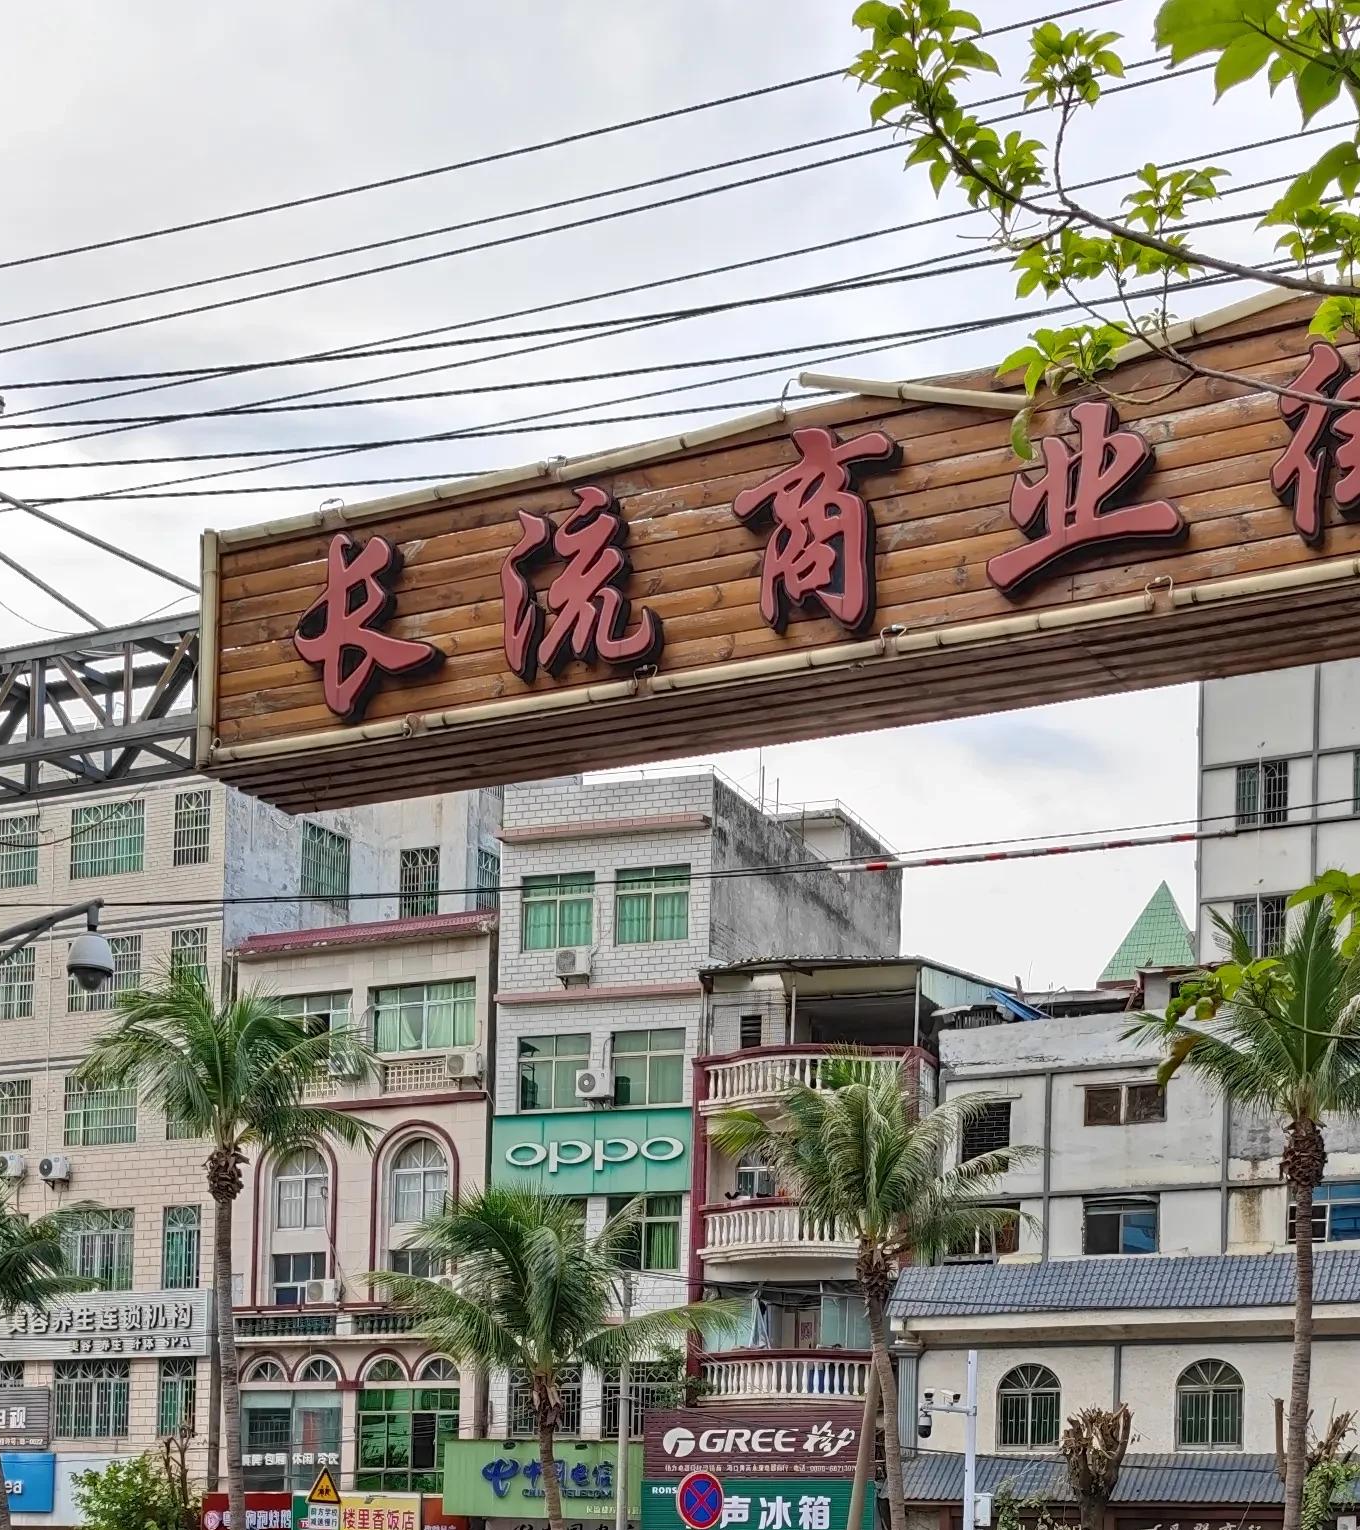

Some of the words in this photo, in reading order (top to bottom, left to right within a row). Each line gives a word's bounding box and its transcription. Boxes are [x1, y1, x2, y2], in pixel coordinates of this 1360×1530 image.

[699, 1429, 799, 1453] GREE
[292, 1452, 314, 1465] 休闲
[523, 1459, 615, 1489] 中国电信
[343, 1508, 415, 1530] 楼里香饭店
[720, 1496, 831, 1530] 声冰箱
